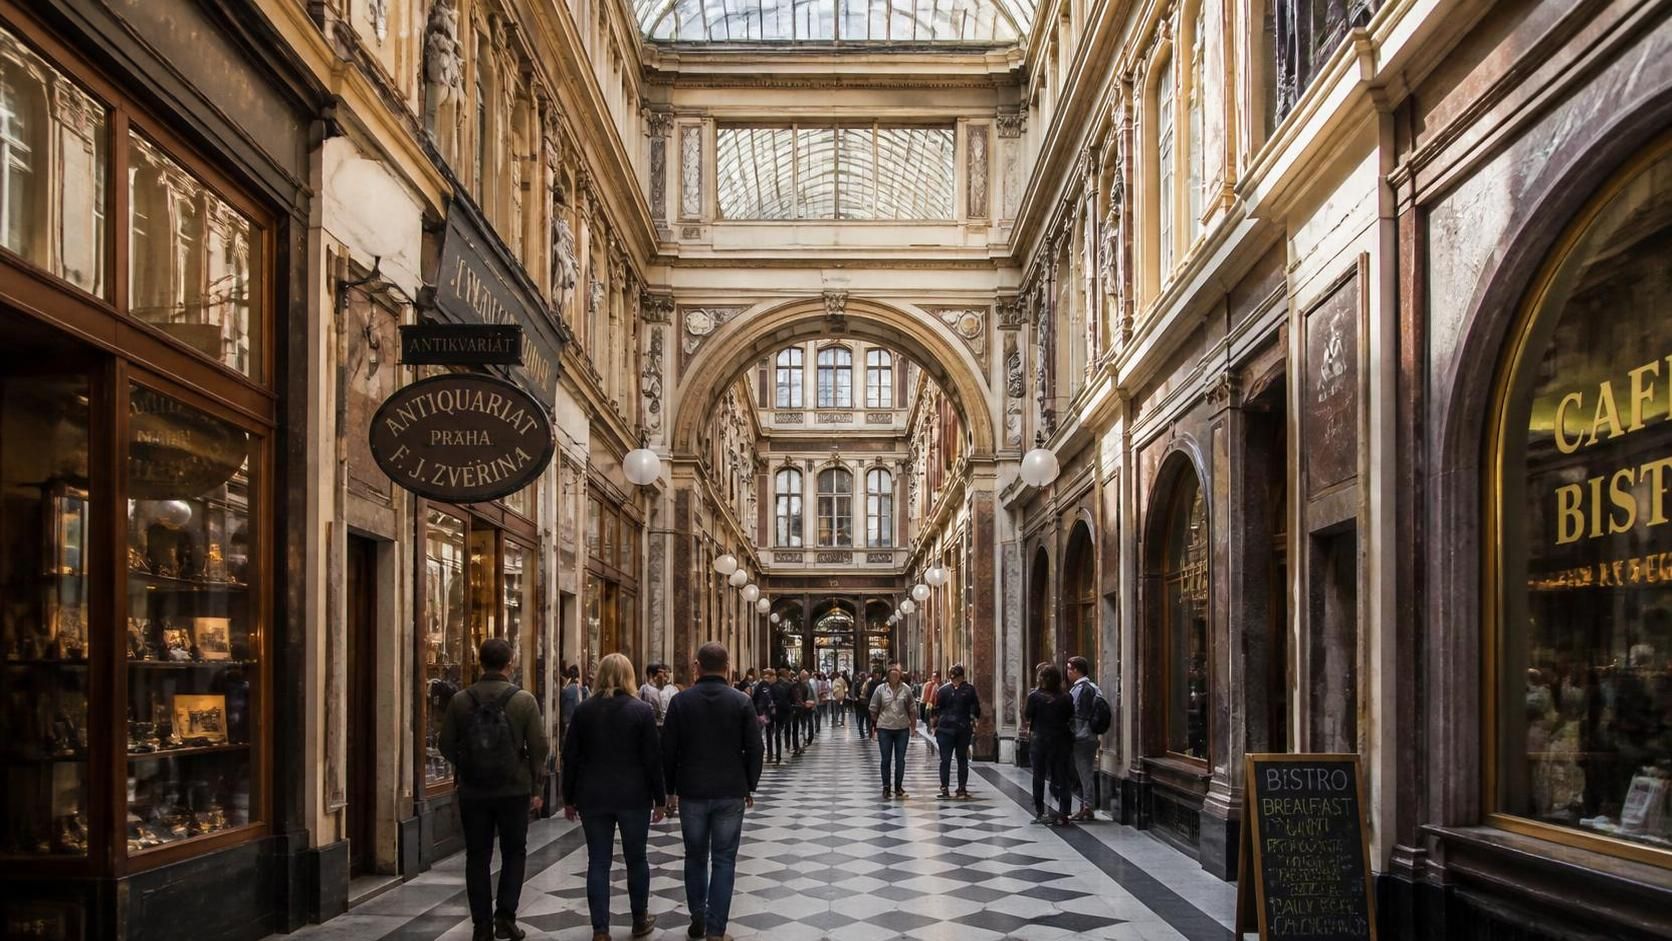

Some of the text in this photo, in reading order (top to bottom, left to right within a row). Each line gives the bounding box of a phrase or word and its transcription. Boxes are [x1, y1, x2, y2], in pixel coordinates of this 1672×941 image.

[385, 389, 538, 437] ANTIQUARIAT
[408, 457, 426, 482] J.
[1555, 456, 1672, 545] BIST
